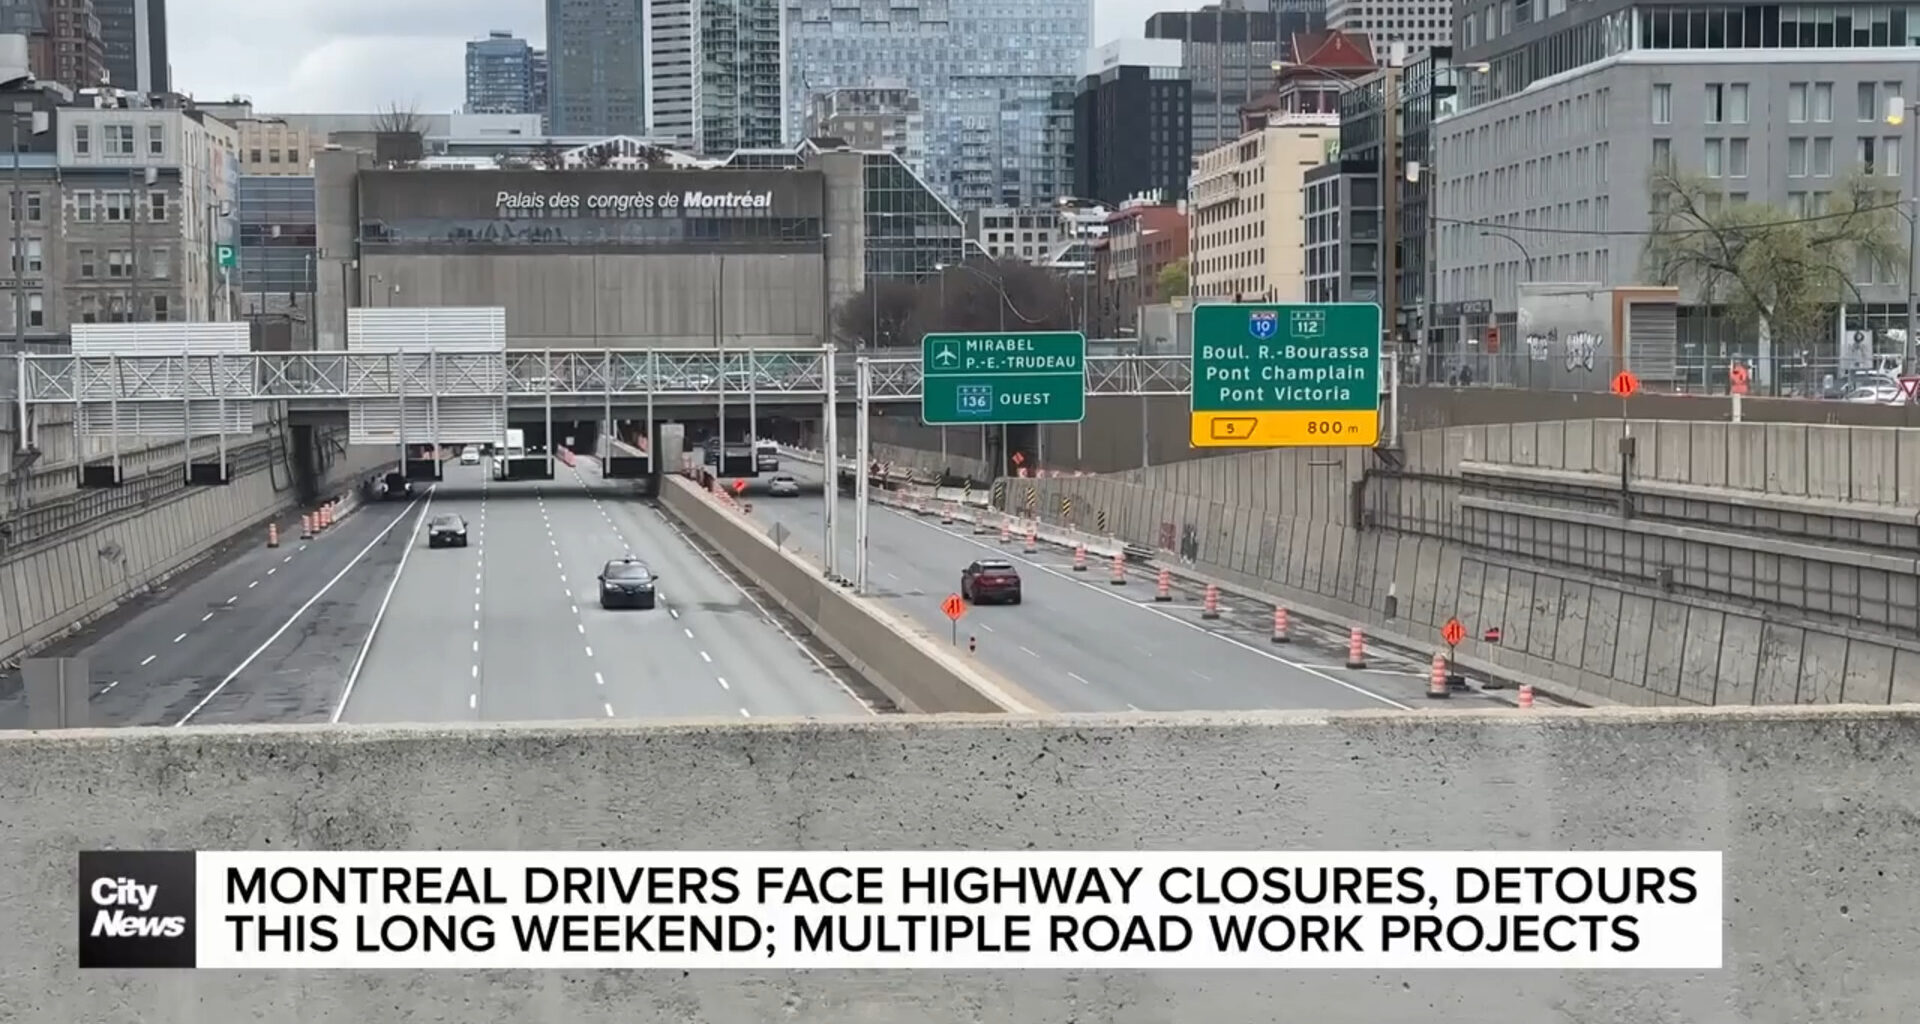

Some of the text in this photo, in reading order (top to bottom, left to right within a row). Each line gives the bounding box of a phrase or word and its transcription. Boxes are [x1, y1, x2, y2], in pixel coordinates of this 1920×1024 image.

[495, 190, 773, 211] Palais des congrès de Montréal
[218, 247, 232, 264] P
[1256, 321, 1271, 332] 10
[1297, 321, 1318, 333] 112
[966, 338, 1035, 352] MIRABEL
[1202, 345, 1369, 360] Boul. R.-Bourassa
[966, 355, 1076, 369] P.-E.-TRUDEAU
[1206, 365, 1365, 384] Pont Champlain
[963, 395, 986, 407] 136
[1000, 393, 1051, 405] OUEST
[1220, 386, 1351, 402] Pont Victoria
[1226, 423, 1235, 434] 5
[1307, 421, 1359, 434] 800 m
